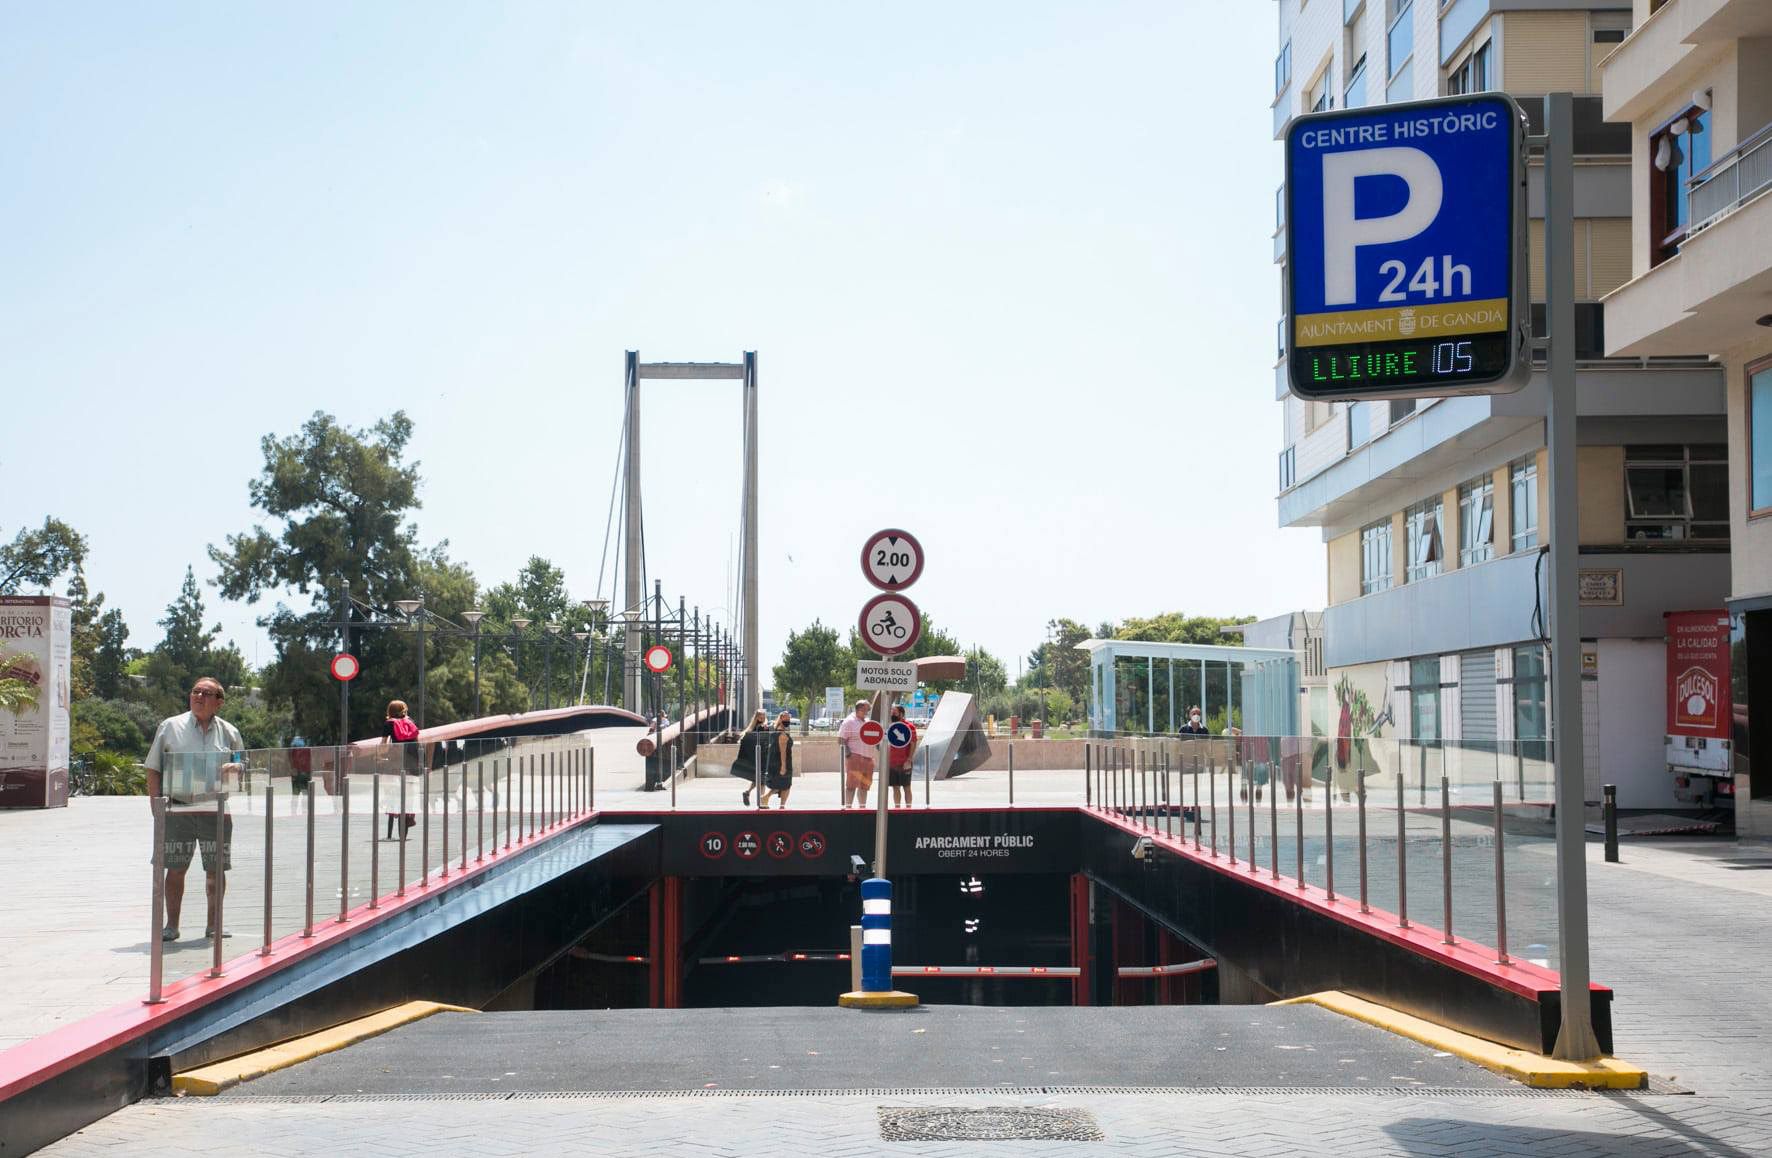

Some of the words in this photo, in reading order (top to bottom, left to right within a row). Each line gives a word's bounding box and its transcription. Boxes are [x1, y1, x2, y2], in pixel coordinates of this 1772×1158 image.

[1301, 123, 1388, 149] CENTRE
[1394, 111, 1497, 139] HISTÒRIC
[1322, 146, 1443, 306] P
[1378, 255, 1472, 303] 24h
[1300, 317, 1393, 338] AJUNTAMENT
[1420, 314, 1439, 329] DE
[1442, 309, 1503, 327] GANDIA
[1312, 351, 1418, 382] LLIURE
[1431, 341, 1472, 375] 105
[876, 550, 910, 568] 2.00
[1677, 639, 1686, 648] LA
[1688, 638, 1718, 648] CALIDAD
[861, 667, 889, 676] MOTOS
[891, 668, 913, 677] SOLO
[864, 676, 908, 686] ABONADOS
[1679, 675, 1715, 705] DULCESOL
[706, 838, 721, 851] 10
[915, 835, 992, 849] APARCAMENT
[993, 832, 1034, 848] PÚBLIC
[938, 849, 967, 858] OBERT
[968, 849, 978, 858] 24
[980, 849, 1010, 857] HORES
